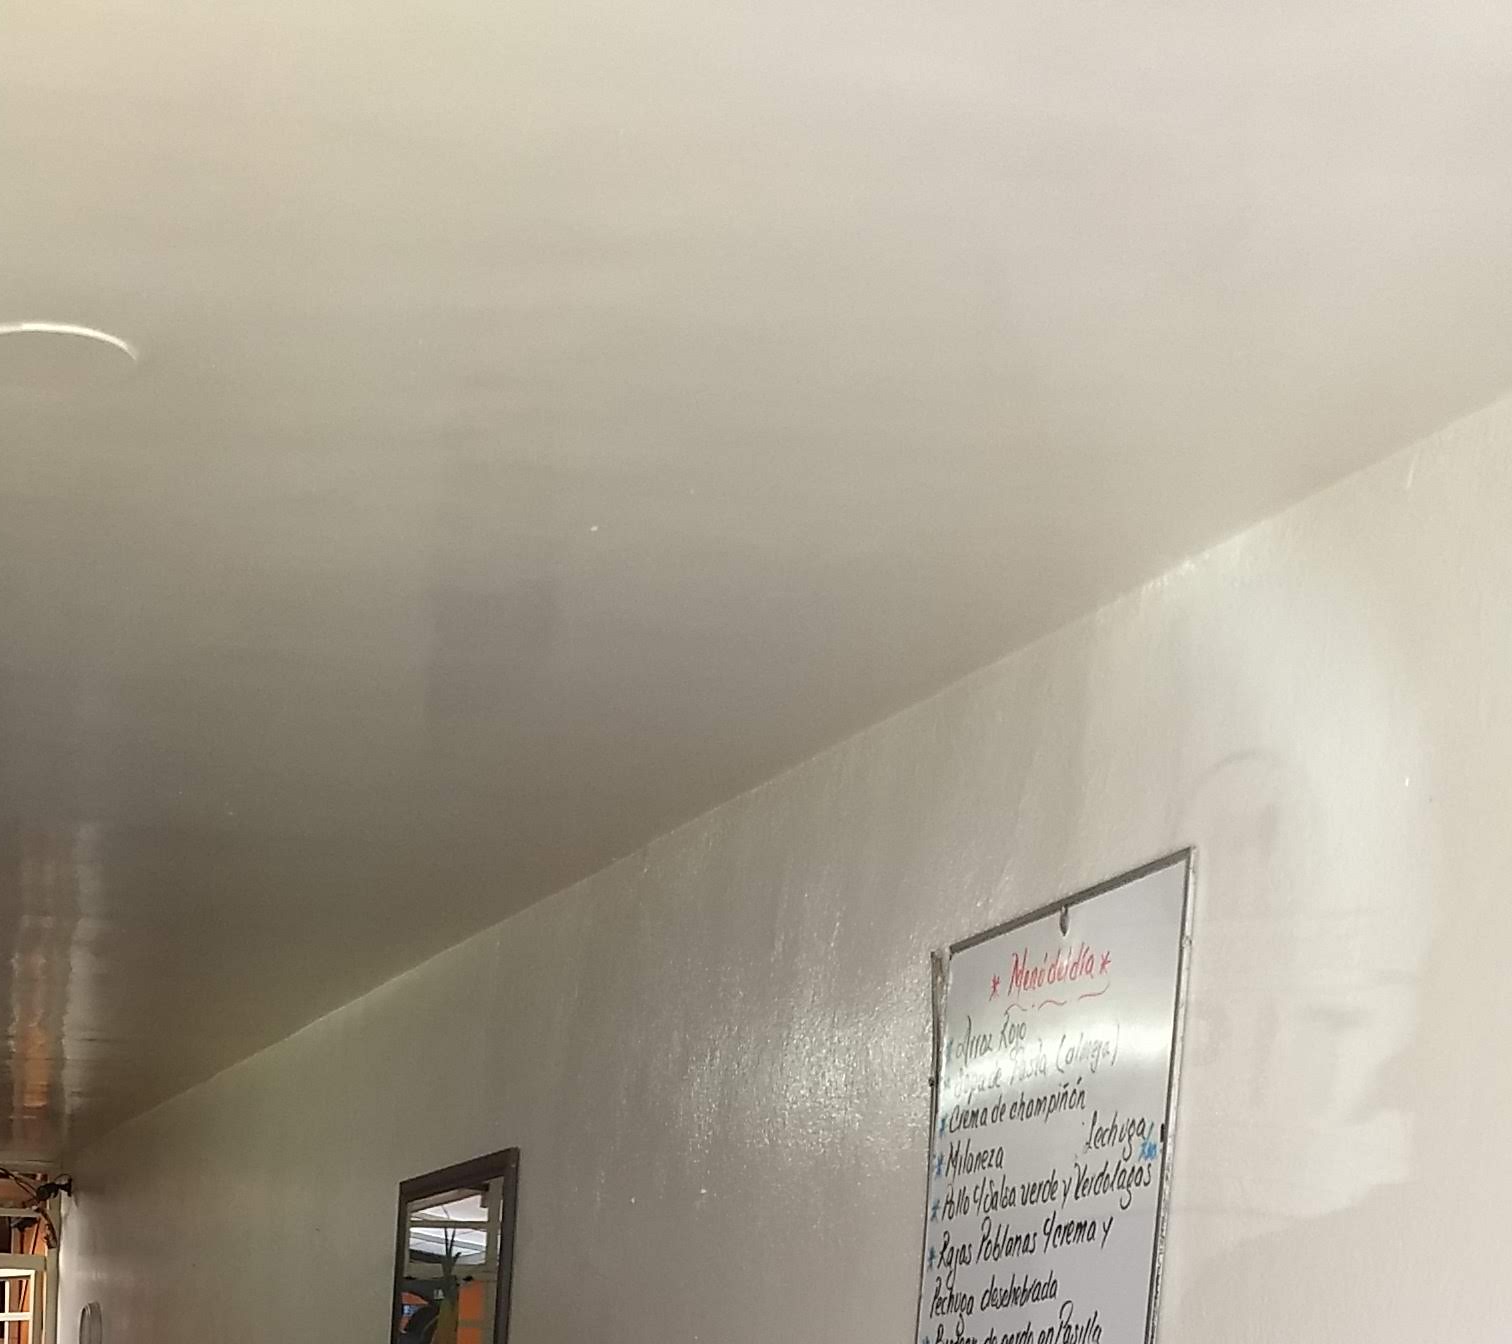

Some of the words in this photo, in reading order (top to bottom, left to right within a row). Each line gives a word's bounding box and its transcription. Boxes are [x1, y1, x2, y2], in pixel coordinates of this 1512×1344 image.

[949, 1100, 987, 1133] Crema
[991, 1095, 1006, 1123] de
[942, 1183, 969, 1221] Pollo
[1021, 1169, 1058, 1205] verde
[1061, 1177, 1072, 1208] y
[938, 1231, 972, 1289] Rajas
[976, 1217, 1037, 1264] Poblanas
[1101, 1216, 1114, 1248] y
[930, 1276, 974, 1336] Pechuga
